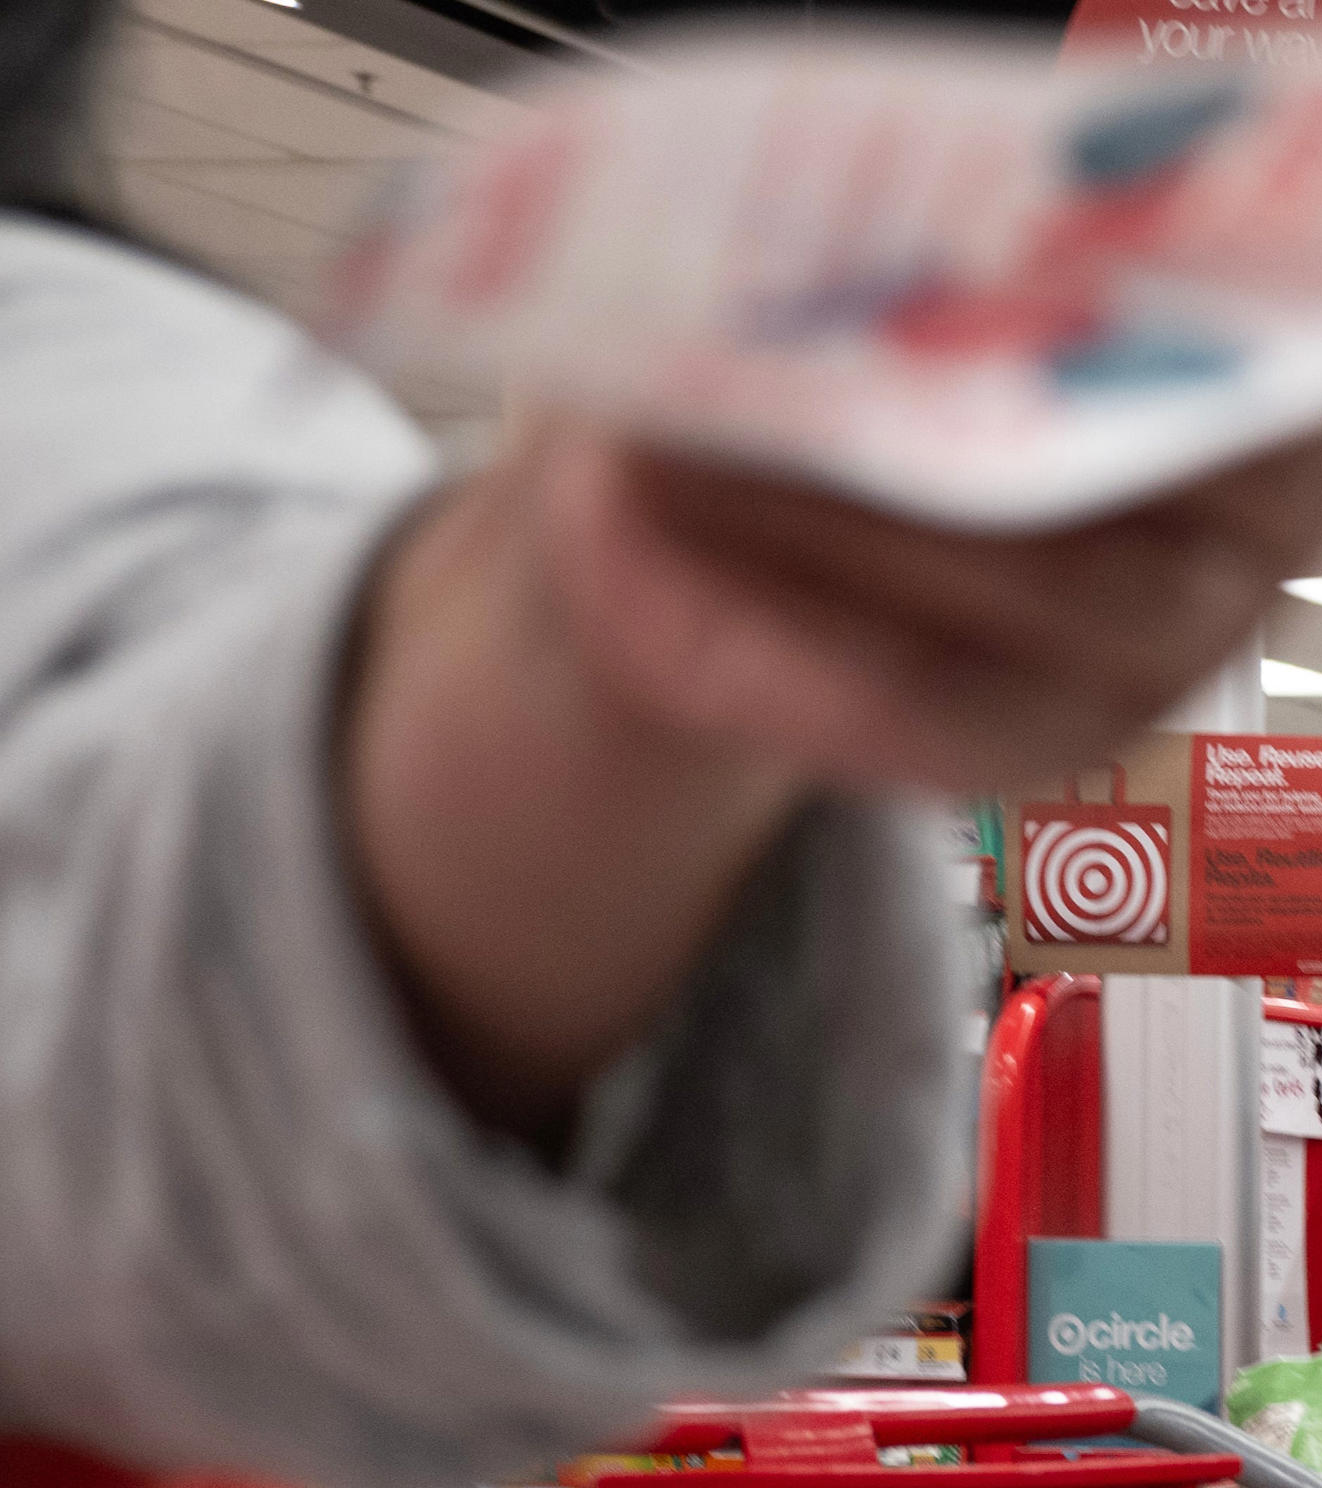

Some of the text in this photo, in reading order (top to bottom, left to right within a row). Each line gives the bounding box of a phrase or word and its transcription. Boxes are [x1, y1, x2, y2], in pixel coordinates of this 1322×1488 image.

[1137, 17, 1235, 65] your
[1079, 1353, 1168, 1388] is here
